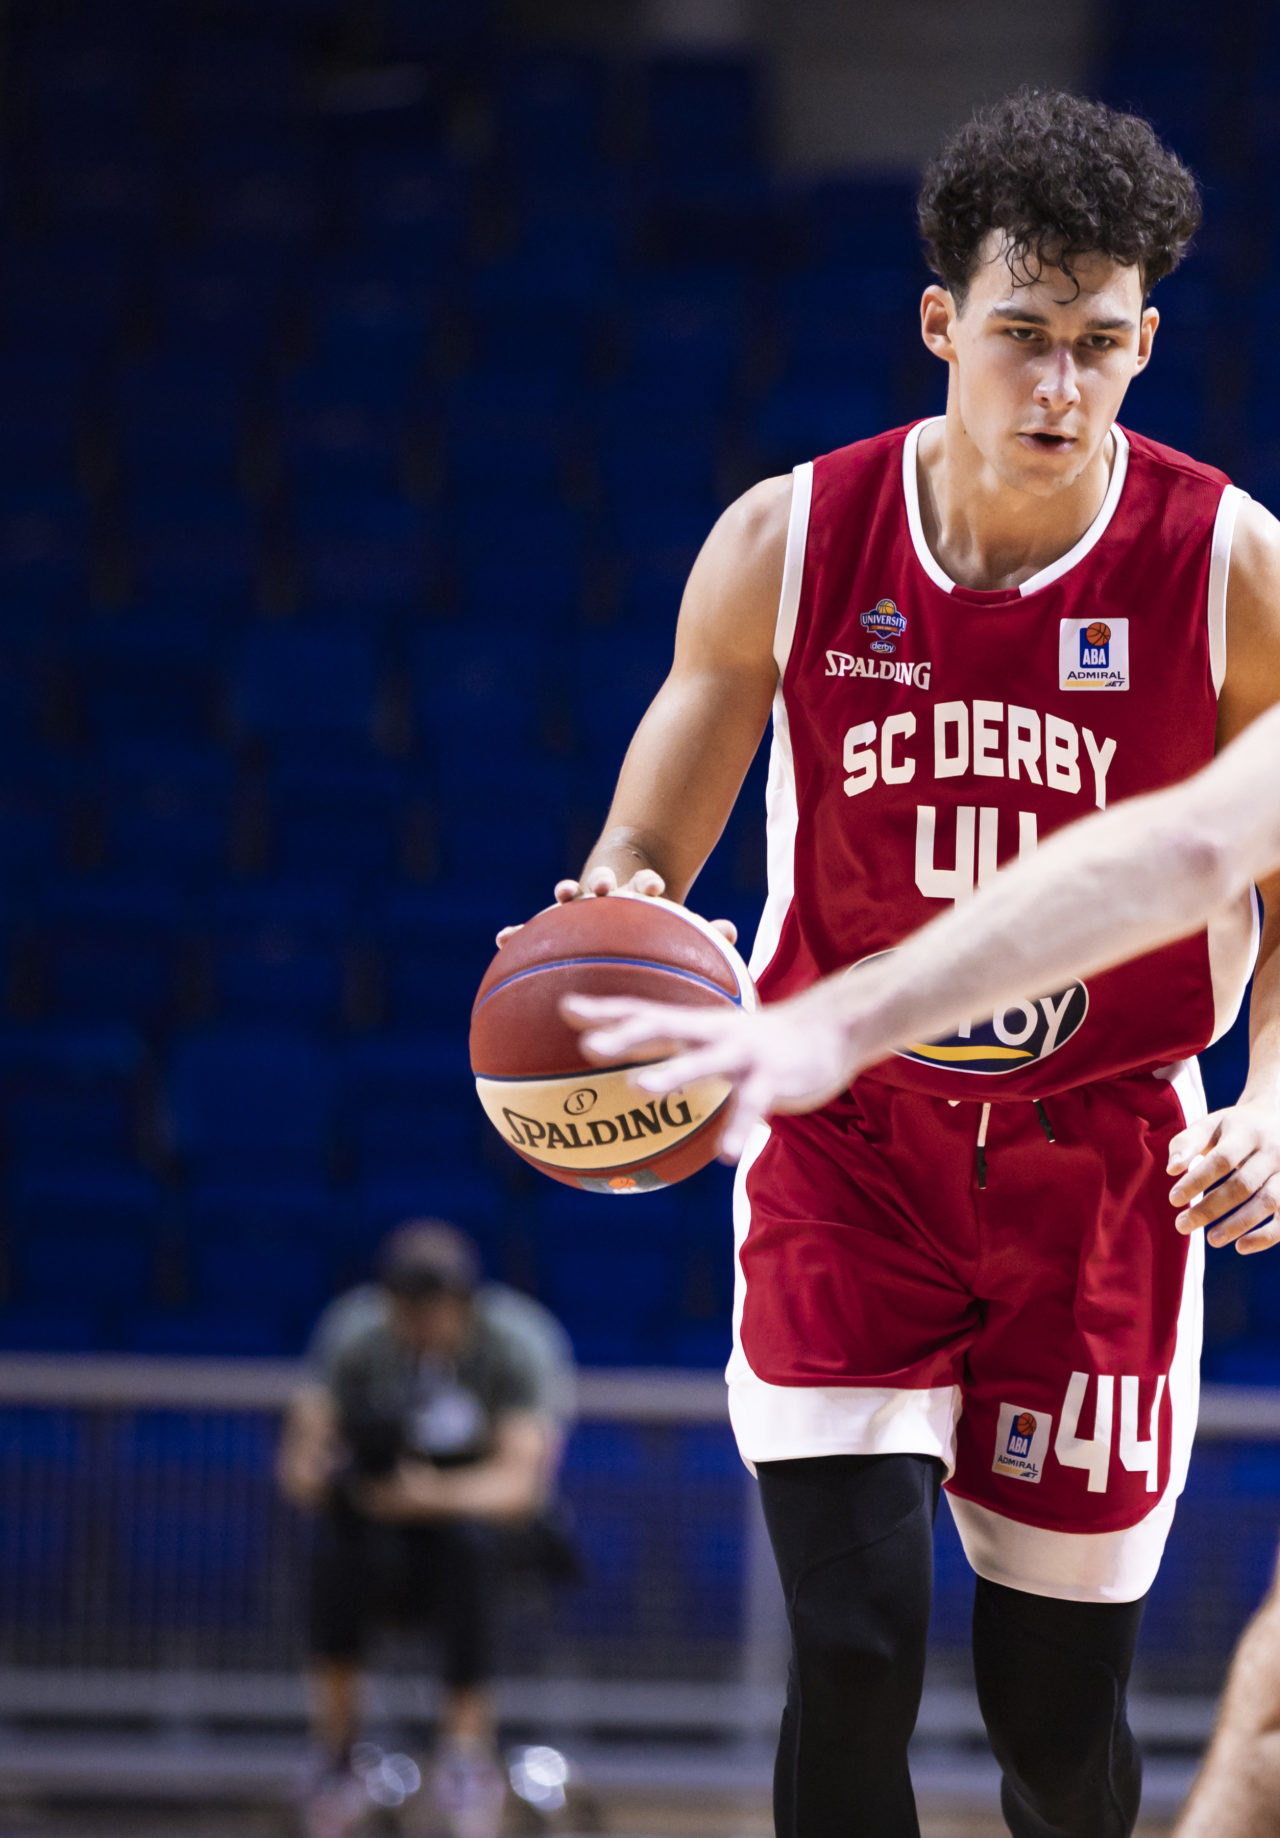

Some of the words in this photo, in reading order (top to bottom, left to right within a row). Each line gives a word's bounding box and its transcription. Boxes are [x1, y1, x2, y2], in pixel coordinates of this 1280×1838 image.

[871, 641, 894, 653] derby
[1082, 648, 1107, 665] ABA
[825, 650, 931, 690] SPALDING
[1067, 670, 1126, 680] ADMIRAL
[843, 711, 916, 797] SC
[934, 700, 1117, 811] DERBY
[502, 1089, 693, 1149] SPALDING
[1054, 1371, 1167, 1493] 44
[1008, 1435, 1029, 1455] ABA
[997, 1454, 1039, 1473] ADMIRAL
